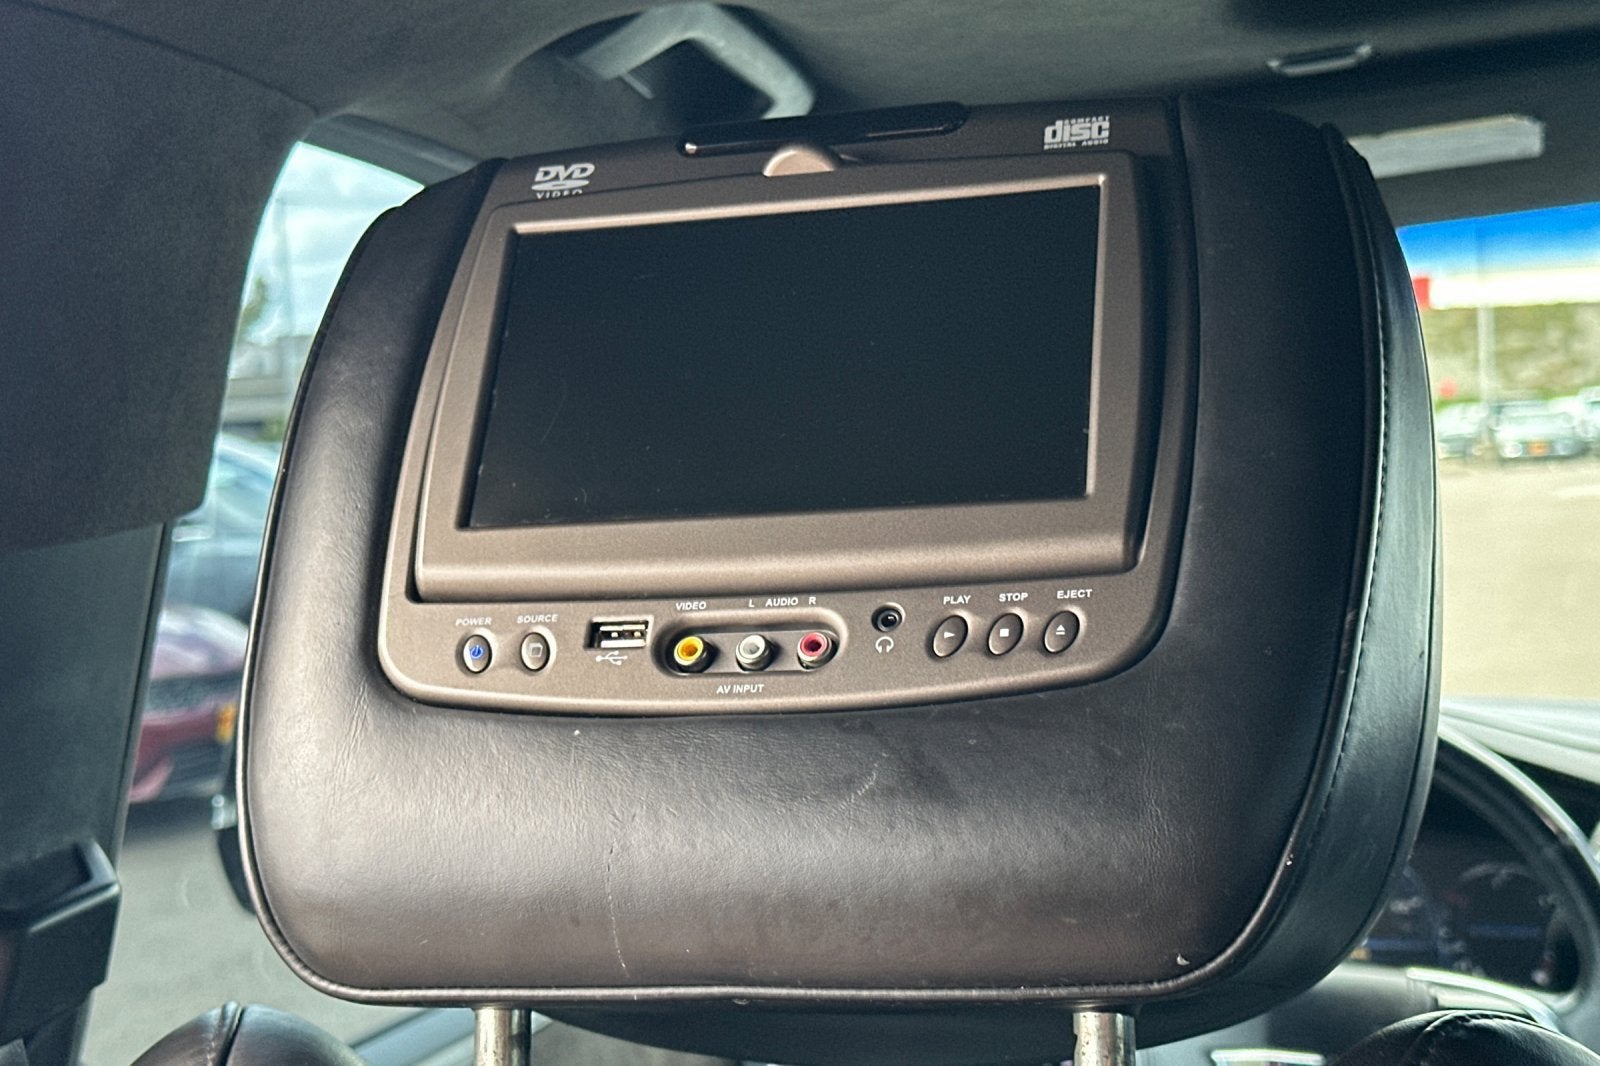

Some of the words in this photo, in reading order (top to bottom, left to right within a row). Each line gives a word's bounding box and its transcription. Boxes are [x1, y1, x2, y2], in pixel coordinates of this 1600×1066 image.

[1044, 120, 1110, 144] disc
[534, 163, 595, 182] DVD
[999, 592, 1029, 602] STOP
[1056, 588, 1093, 599] EJECT
[675, 600, 707, 611] VIDEO
[748, 599, 755, 608] L
[765, 596, 799, 607] AUDIO
[808, 596, 817, 605] R
[943, 595, 971, 605] PLAY
[455, 616, 493, 626] POWER
[516, 613, 559, 624] SOURCE
[716, 684, 731, 694] AV
[733, 683, 765, 694] INPUT
